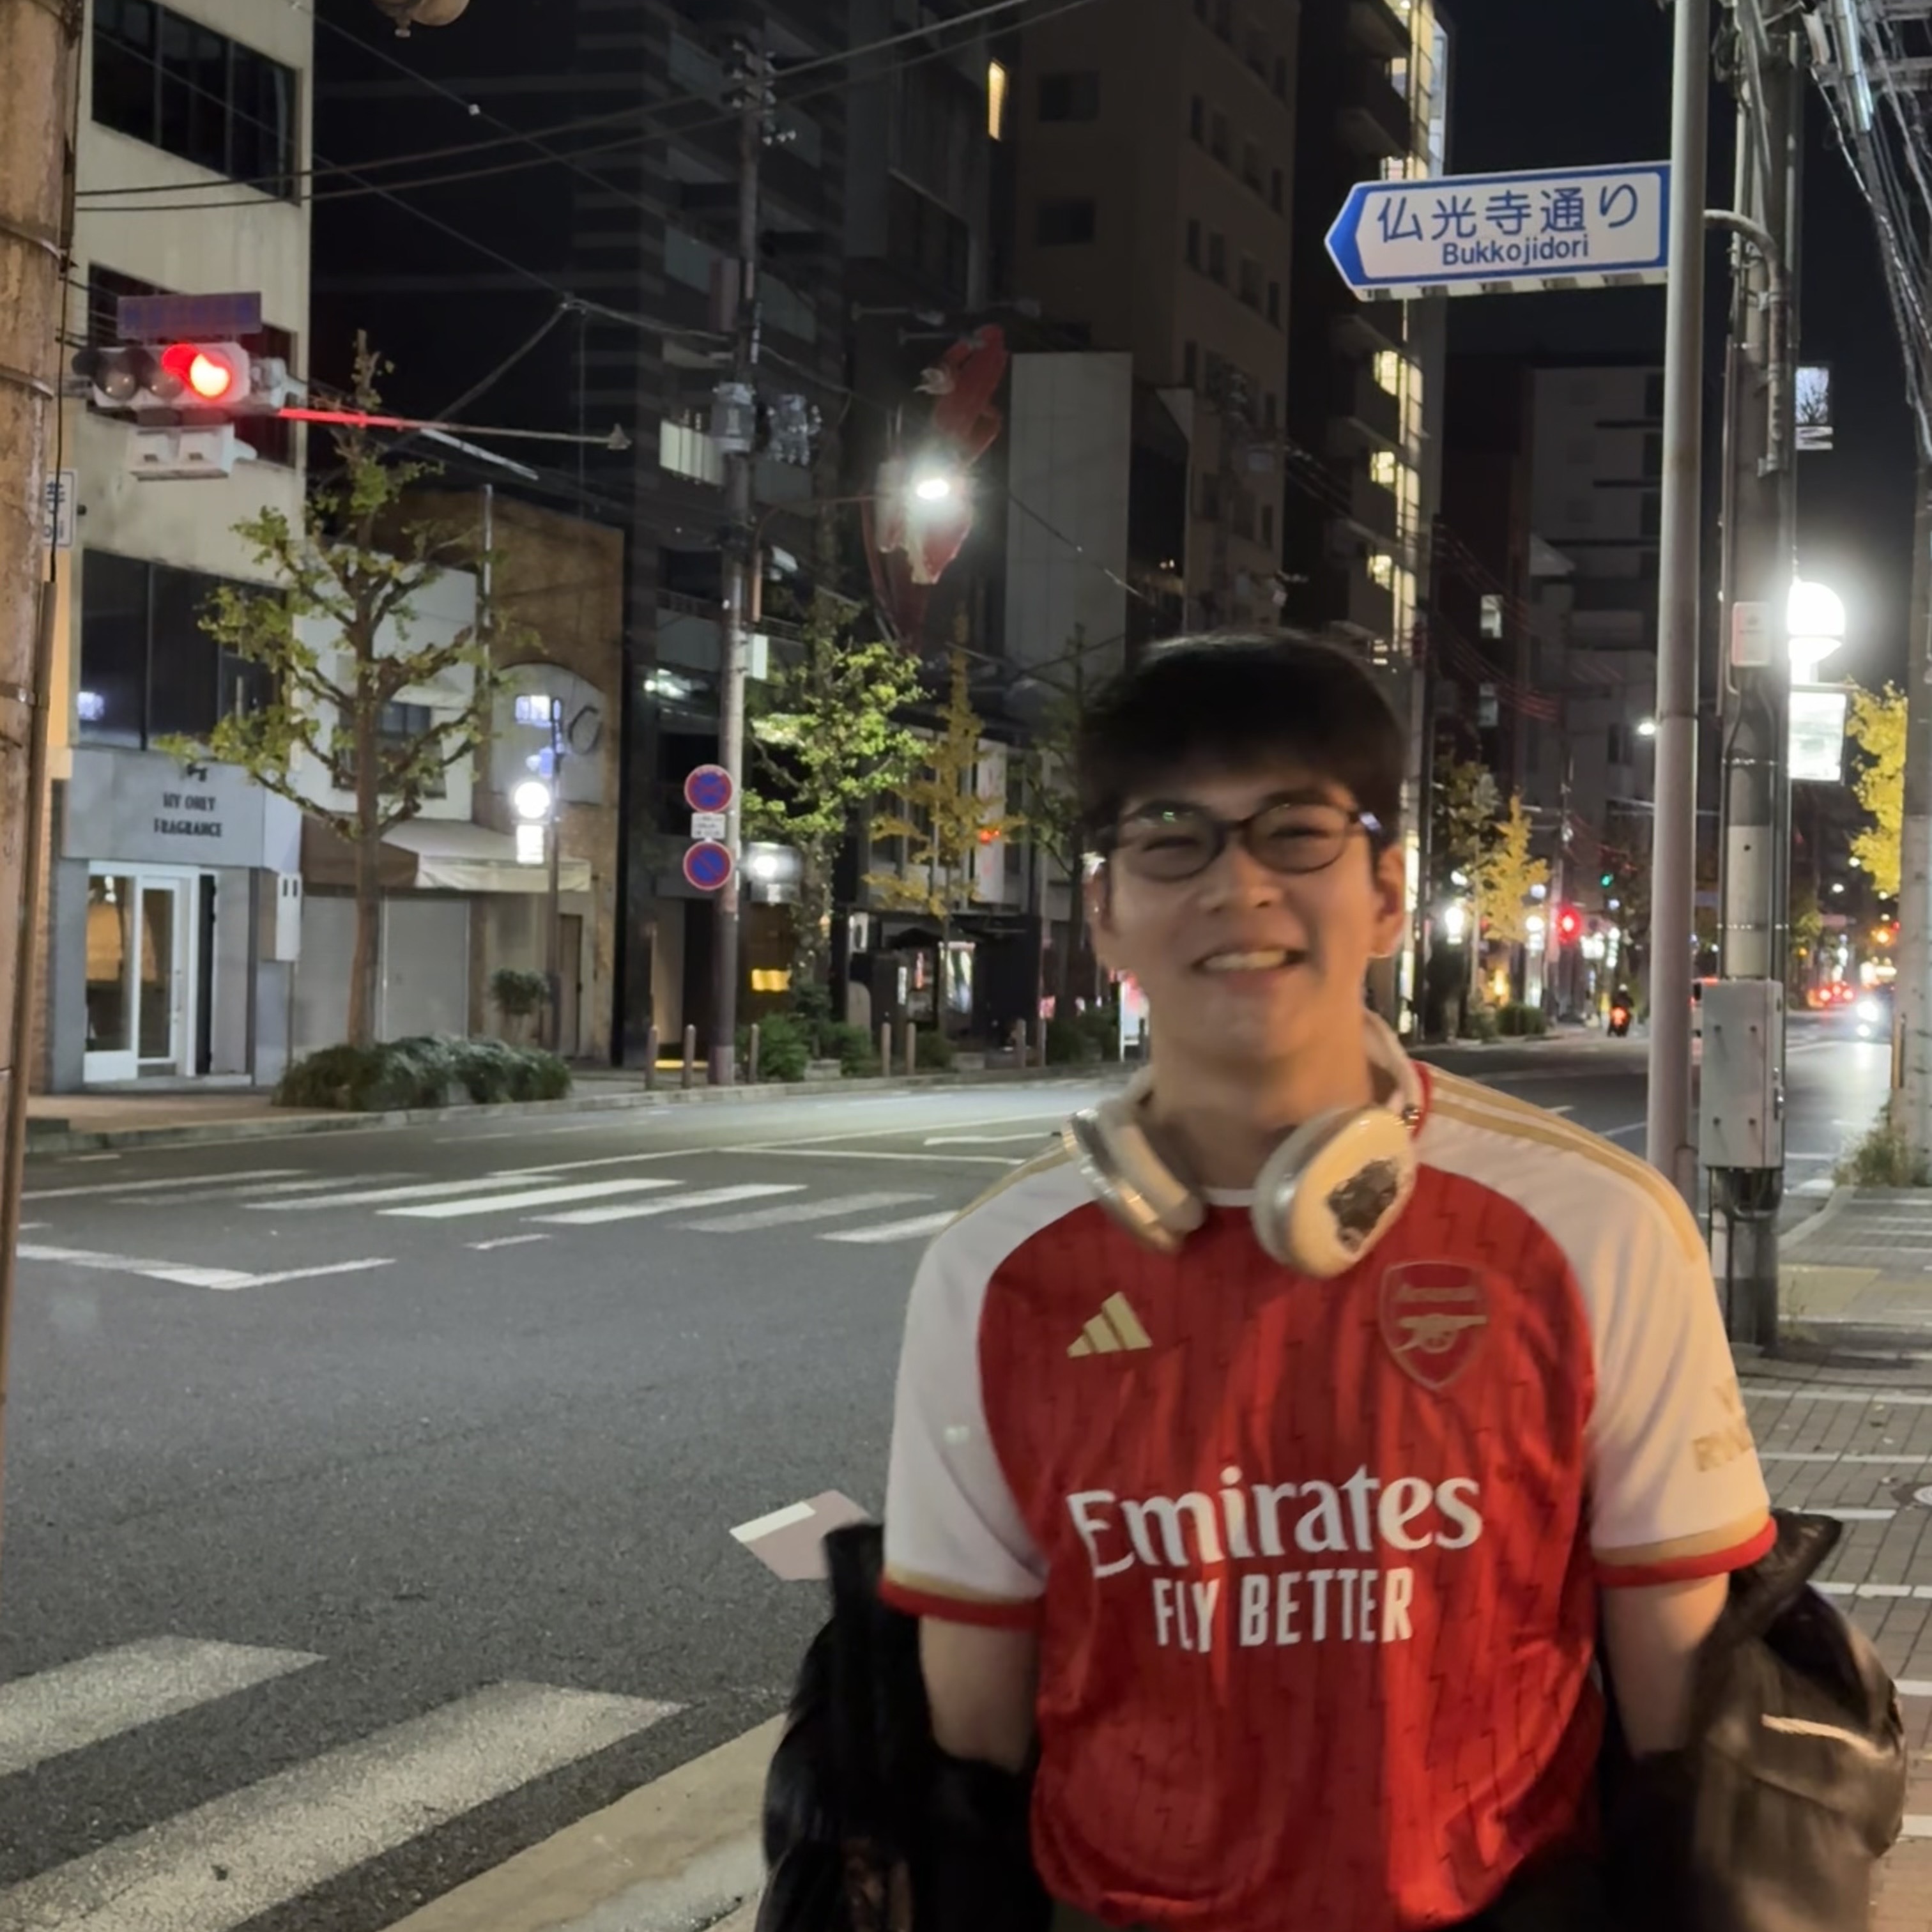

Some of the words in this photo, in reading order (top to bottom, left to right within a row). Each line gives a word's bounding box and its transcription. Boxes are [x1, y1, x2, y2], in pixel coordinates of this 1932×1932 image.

[1377, 183, 1638, 243] 仏光寺通り
[1442, 234, 1590, 266] Bukkojidori
[1066, 1464, 1484, 1579] Emirates
[1152, 1577, 1220, 1653] FLY
[1239, 1567, 1414, 1648] BETTER
